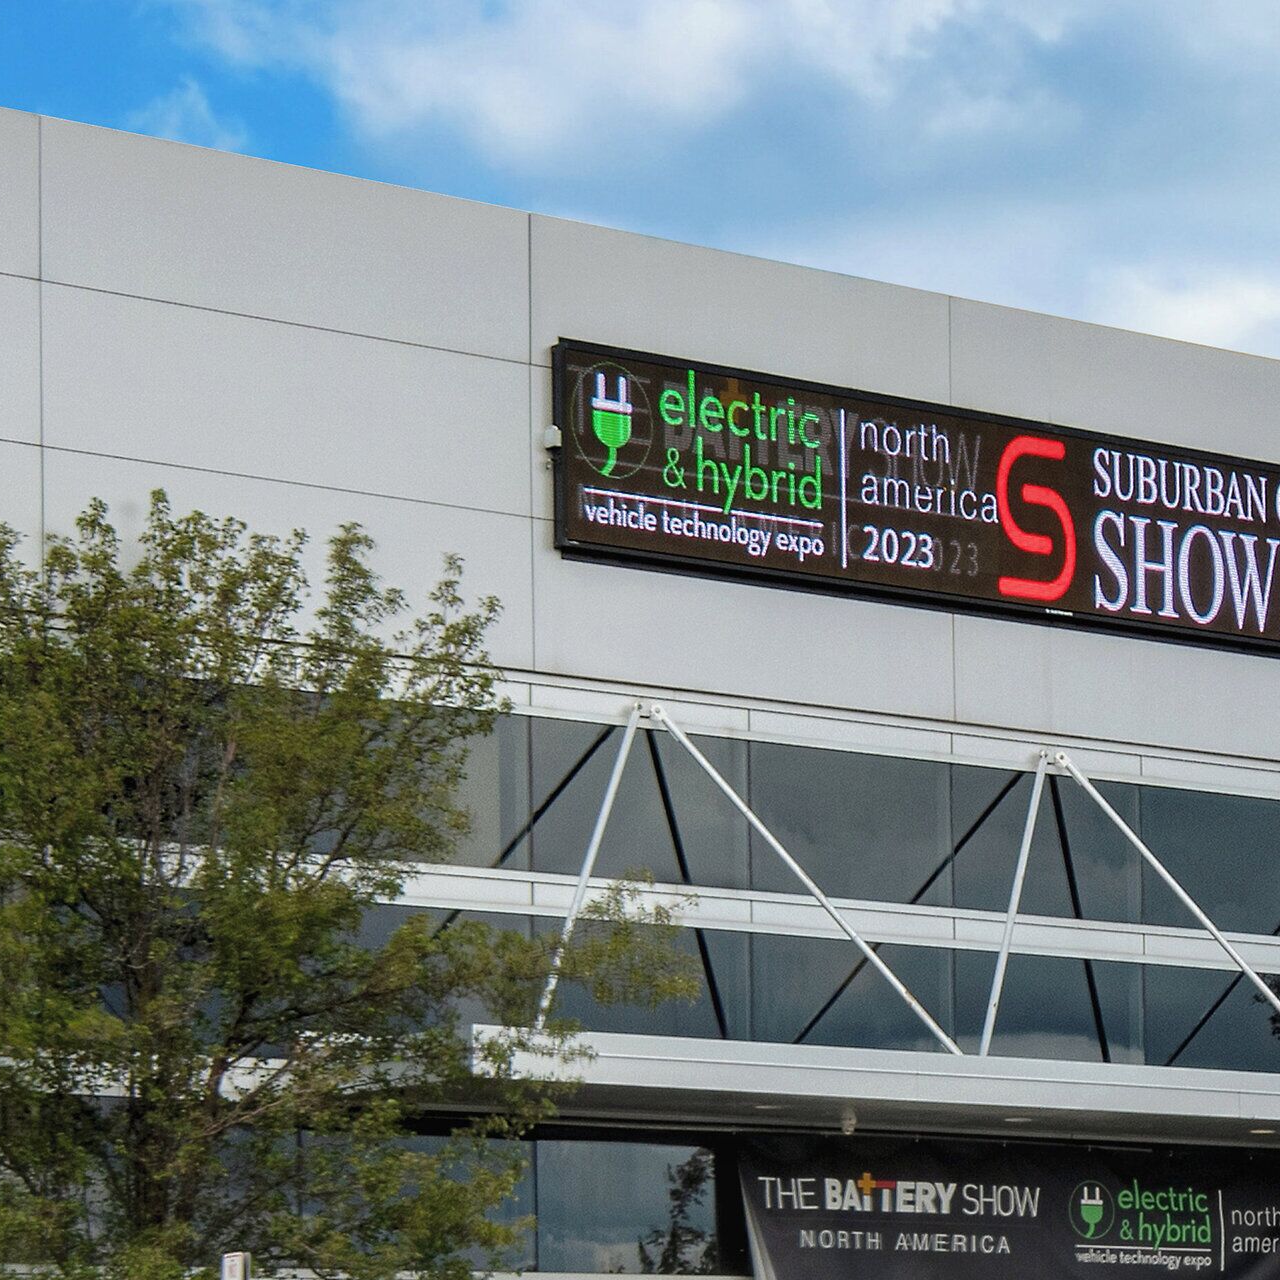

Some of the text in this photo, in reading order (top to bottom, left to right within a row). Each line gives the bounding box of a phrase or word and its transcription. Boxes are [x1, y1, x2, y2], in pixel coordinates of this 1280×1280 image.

[659, 369, 821, 449] electric
[860, 421, 950, 464] north
[662, 435, 822, 513] & hybrid
[1093, 448, 1268, 524] SUBURBAN
[861, 473, 999, 524] america
[583, 499, 657, 532] vehicle
[662, 510, 772, 557] technology
[776, 532, 825, 563] expo
[863, 525, 935, 569] 2023
[758, 1172, 1040, 1218] THE BATTERY SHOW
[1118, 1179, 1209, 1213] electric
[799, 1229, 1011, 1255] NORTH AMERICA
[1120, 1212, 1212, 1251] & hybrid
[1074, 1249, 1212, 1271] vehicle technology expo
